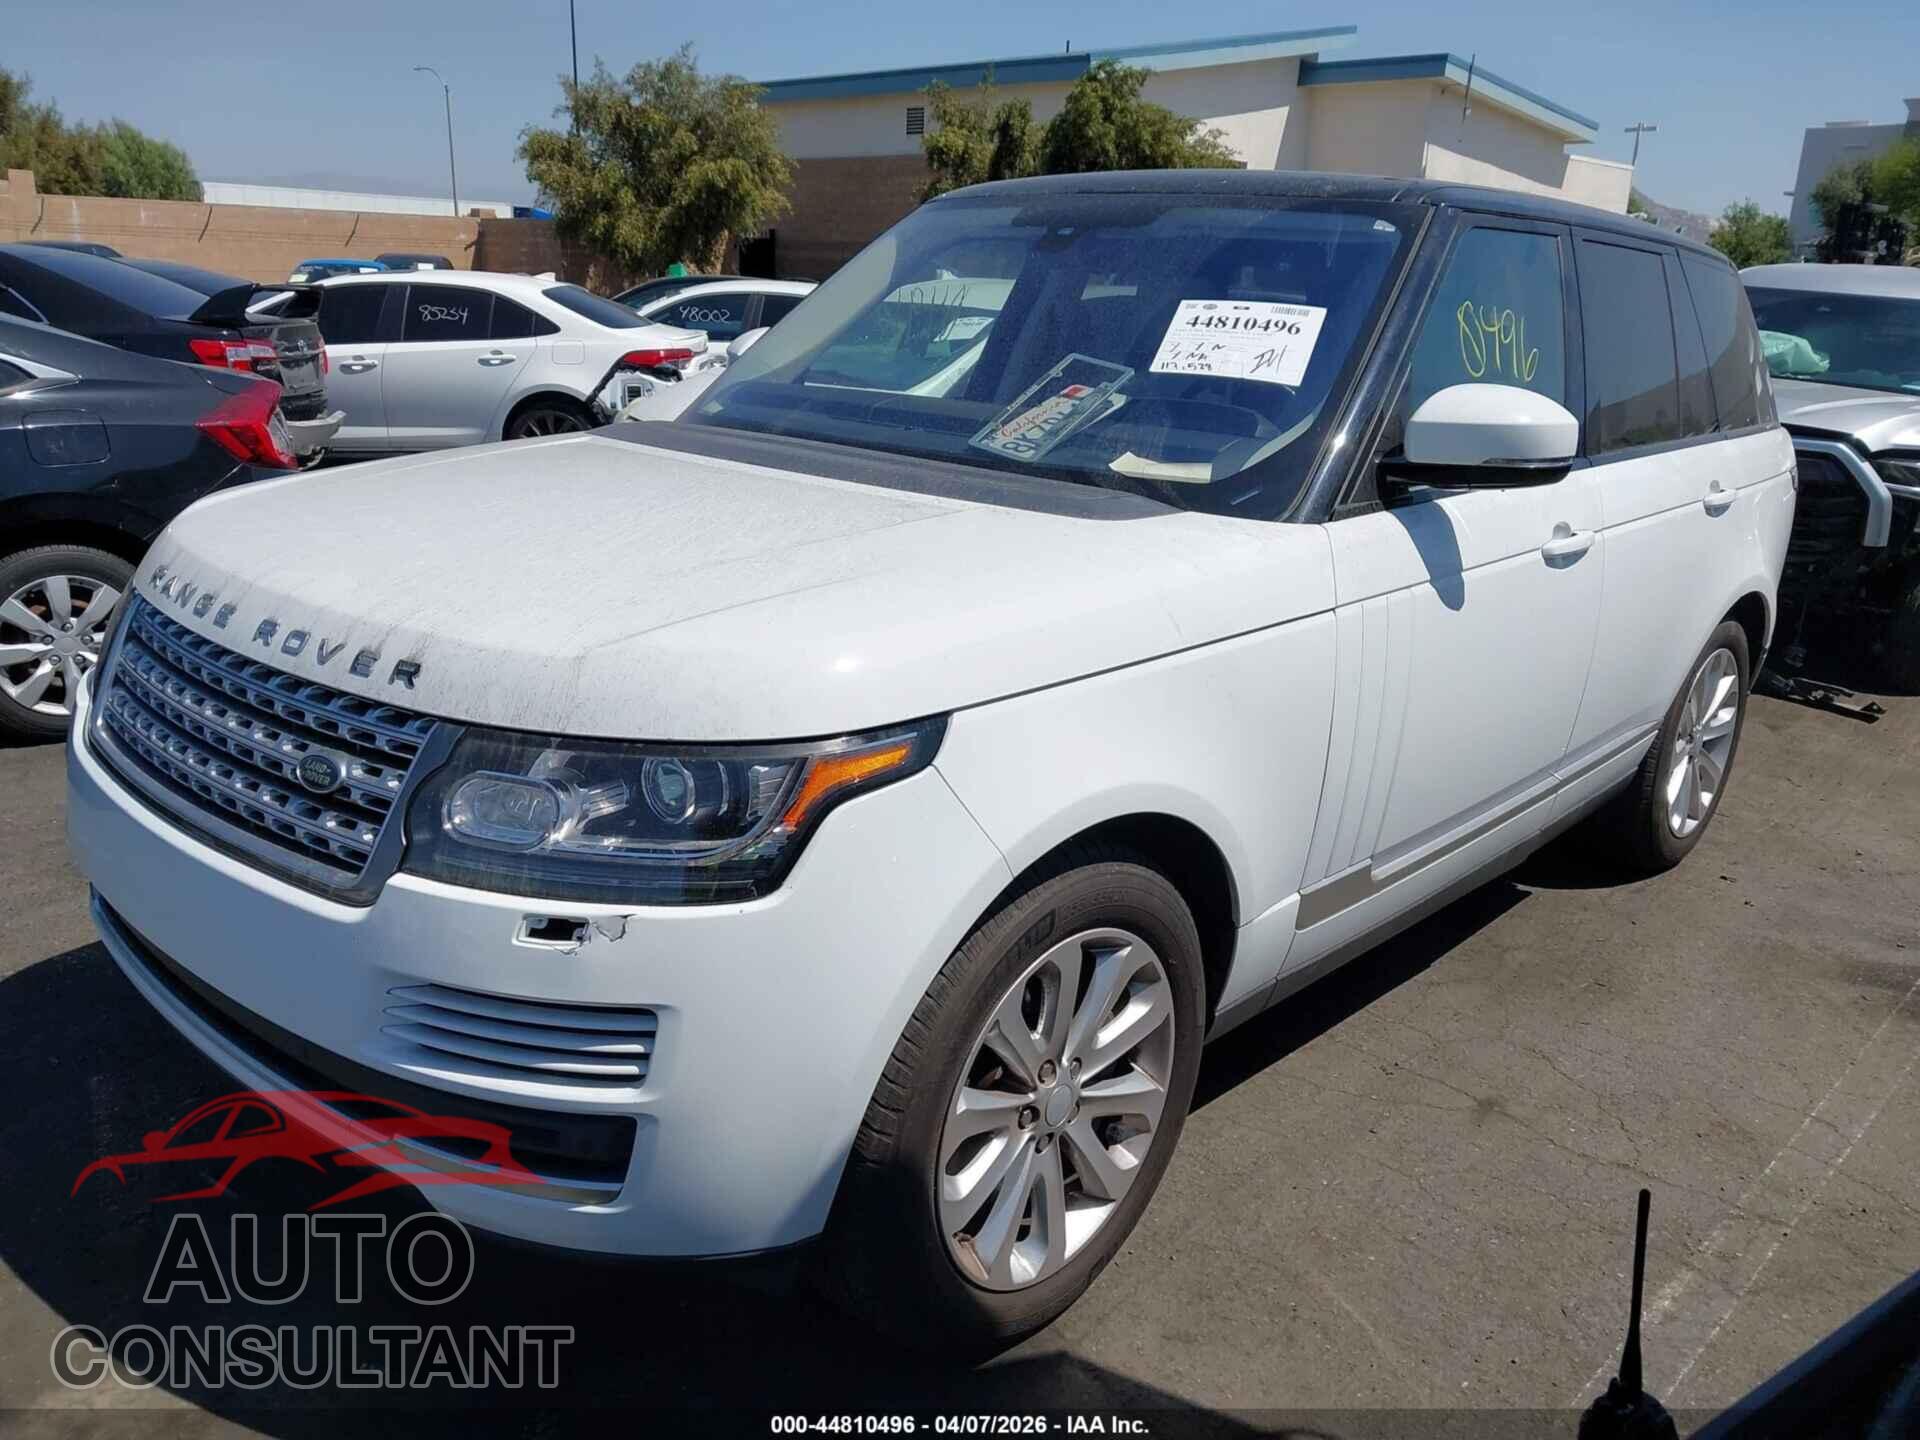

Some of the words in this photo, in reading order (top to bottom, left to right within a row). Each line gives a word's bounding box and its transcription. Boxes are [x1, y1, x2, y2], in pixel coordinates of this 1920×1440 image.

[1185, 314, 1302, 336] 44810496
[150, 565, 238, 629] RANGE
[252, 618, 421, 690] ROVER
